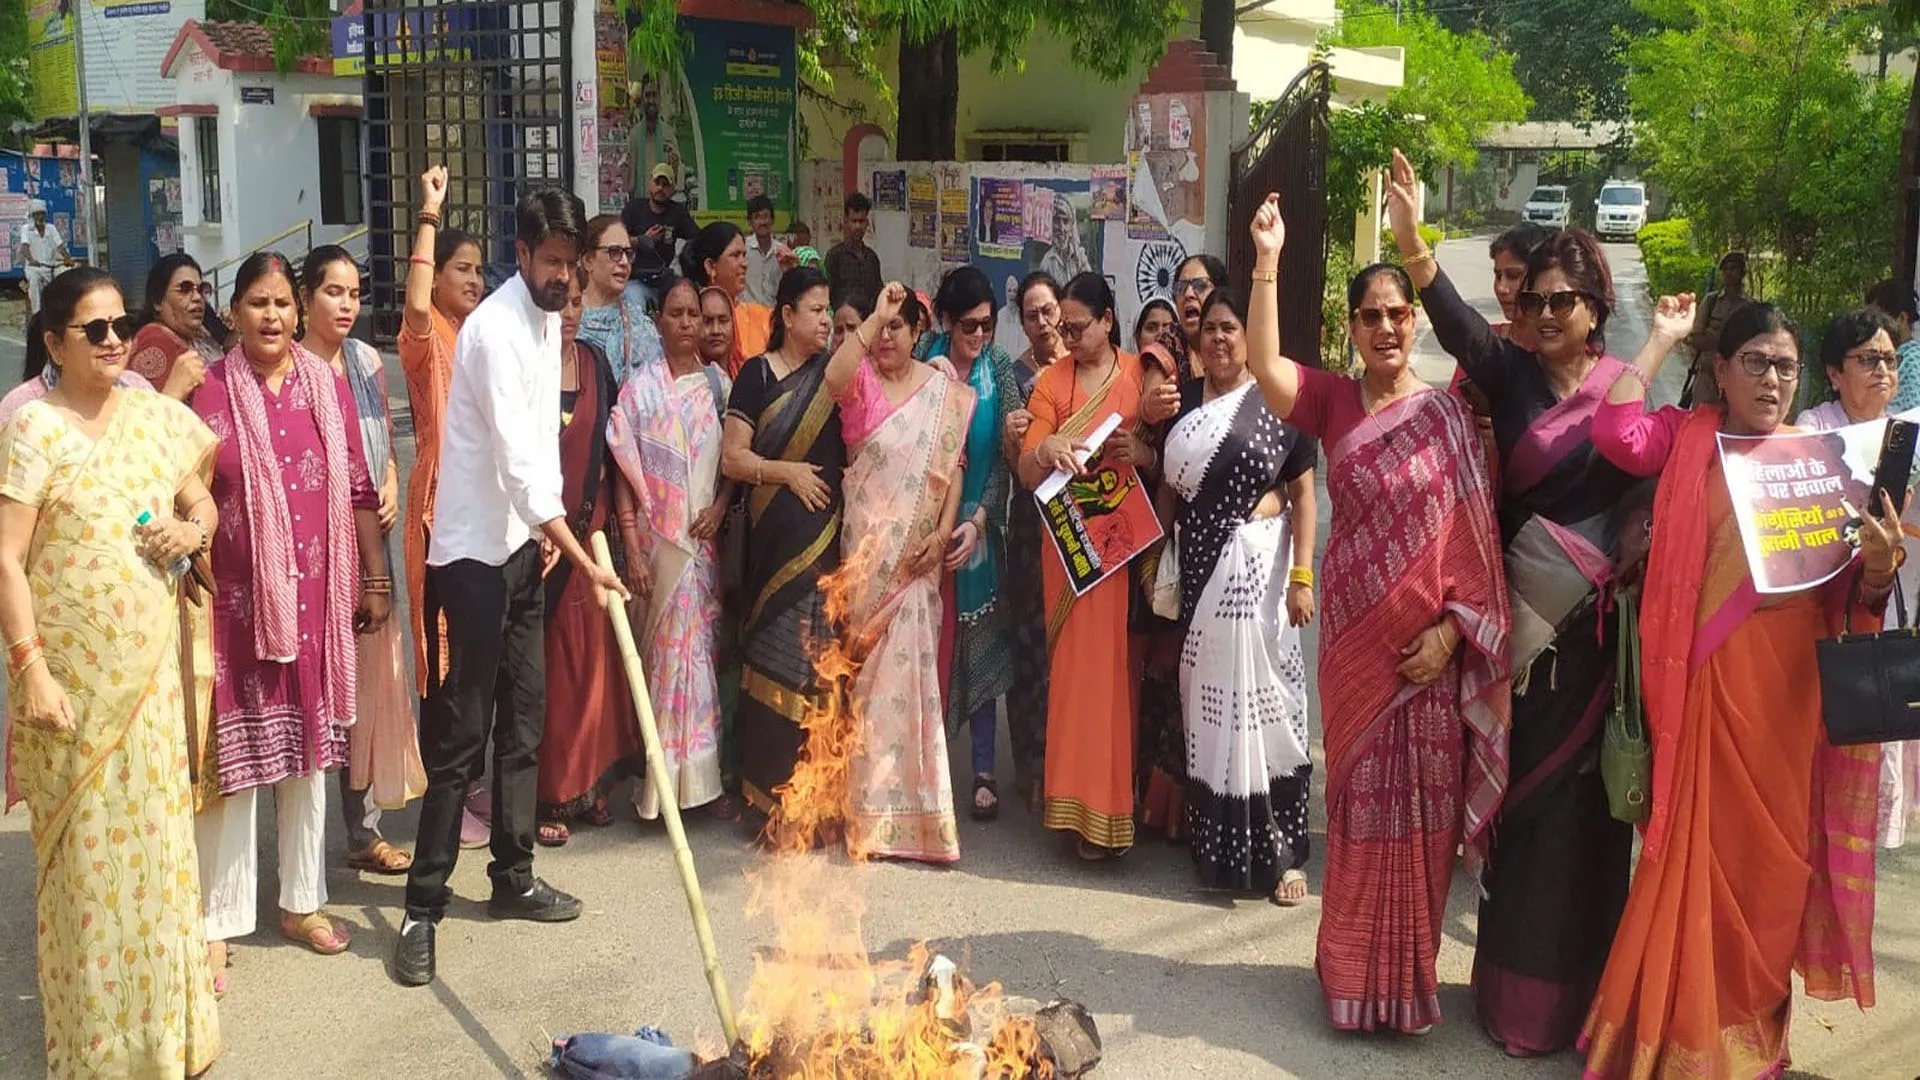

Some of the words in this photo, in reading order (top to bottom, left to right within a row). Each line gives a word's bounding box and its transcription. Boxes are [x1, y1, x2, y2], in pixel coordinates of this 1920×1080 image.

[1751, 458, 1808, 483] हिलाओं
[1807, 457, 1827, 476] के
[1765, 482, 1790, 499] पर
[1790, 475, 1843, 498] सवाल
[1801, 527, 1839, 547] चाल
